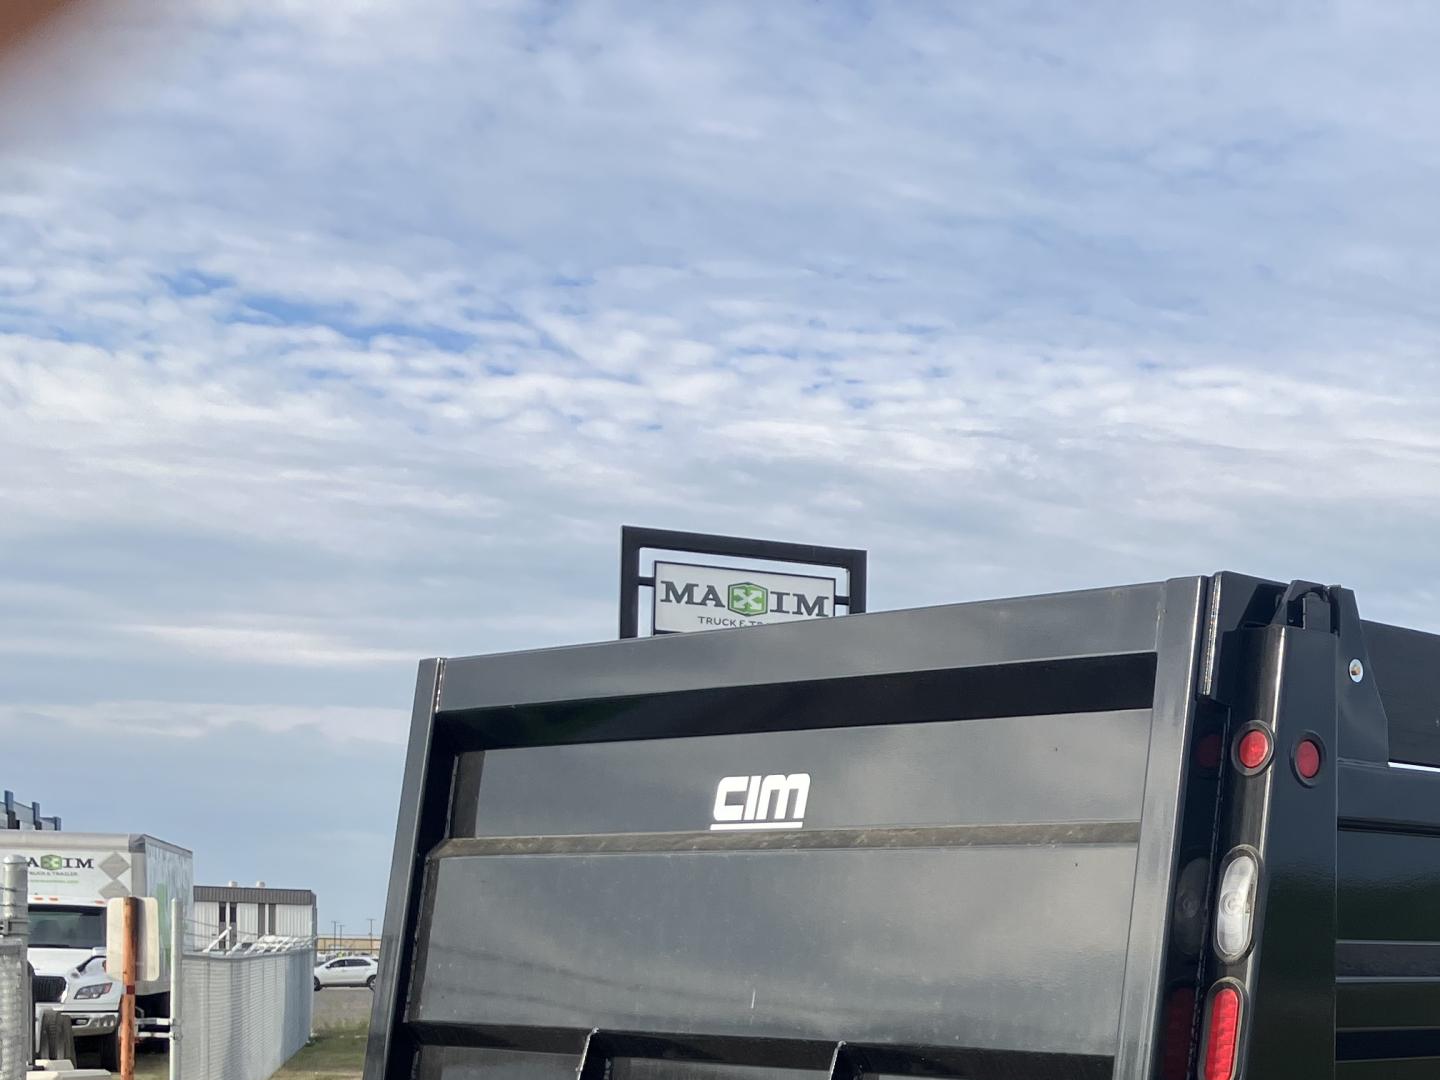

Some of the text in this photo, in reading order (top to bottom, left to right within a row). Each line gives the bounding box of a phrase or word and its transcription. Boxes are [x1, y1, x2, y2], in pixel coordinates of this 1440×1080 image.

[660, 580, 829, 618] MAXIM
[697, 616, 737, 628] TRUCK
[25, 854, 95, 871] AXIM
